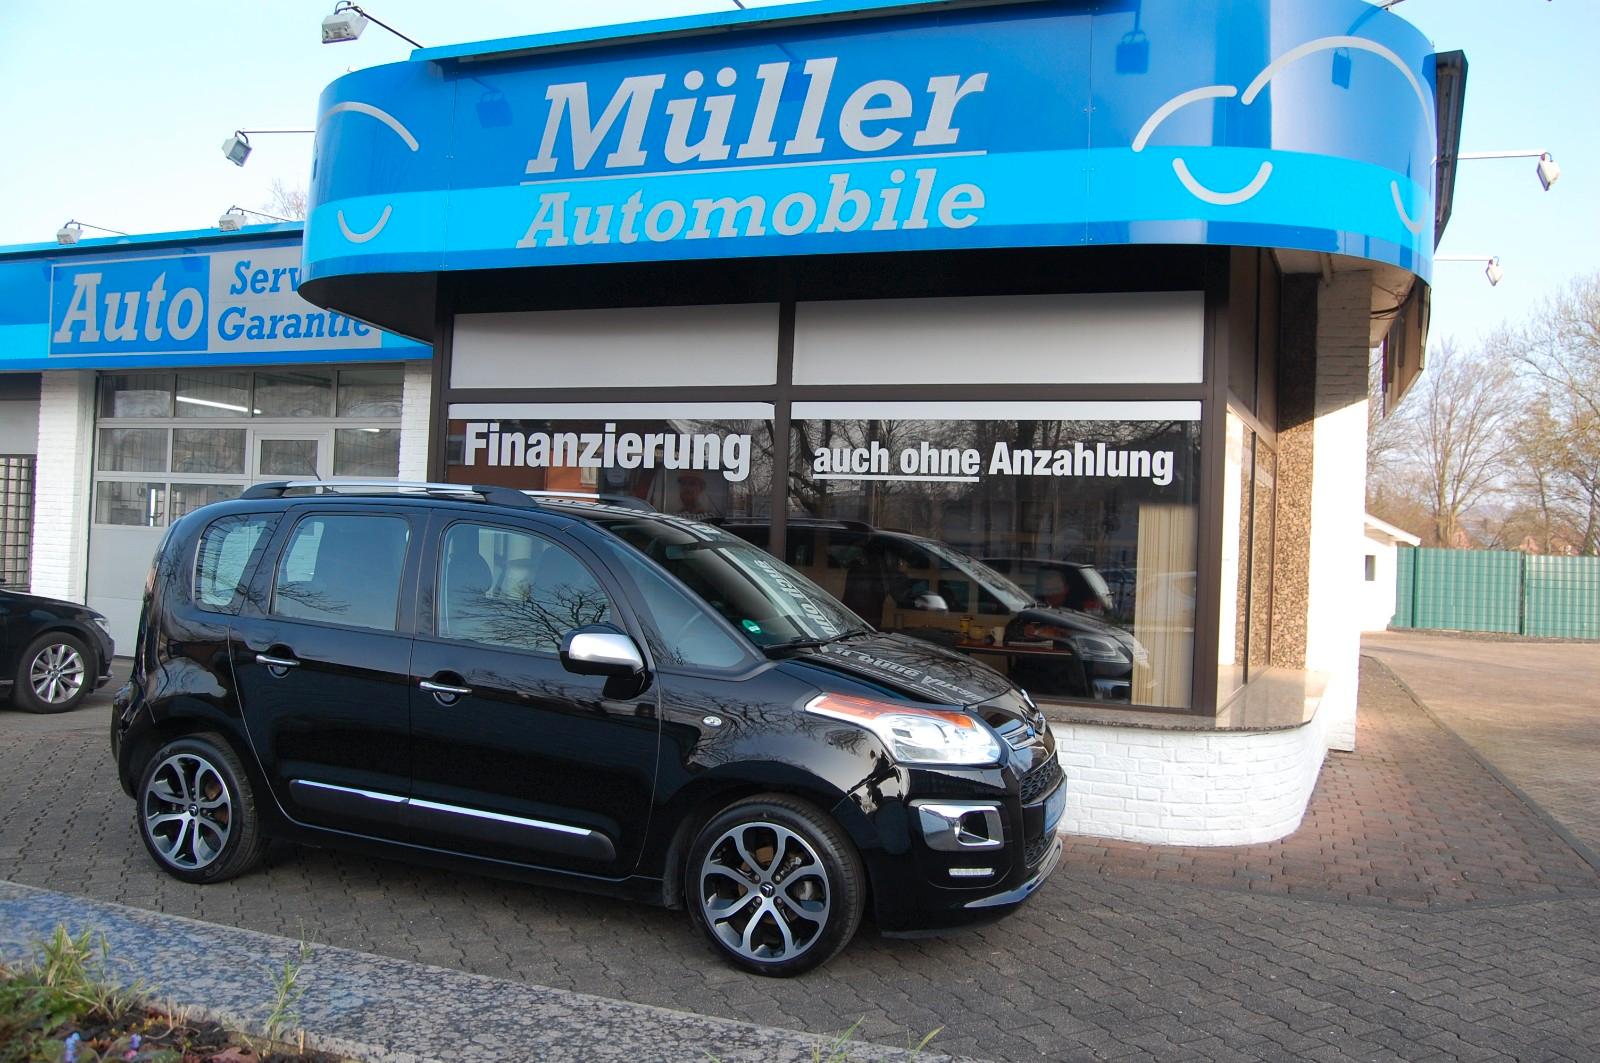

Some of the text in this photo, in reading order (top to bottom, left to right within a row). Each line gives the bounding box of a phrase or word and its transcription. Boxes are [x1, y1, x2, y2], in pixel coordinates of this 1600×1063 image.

[525, 57, 988, 174] Müller
[516, 168, 986, 249] Automobile
[53, 271, 204, 344] Auto
[229, 259, 302, 295] Serv
[464, 422, 752, 482] Finanzierung
[813, 441, 1174, 486] auch ohne Anzahlung
